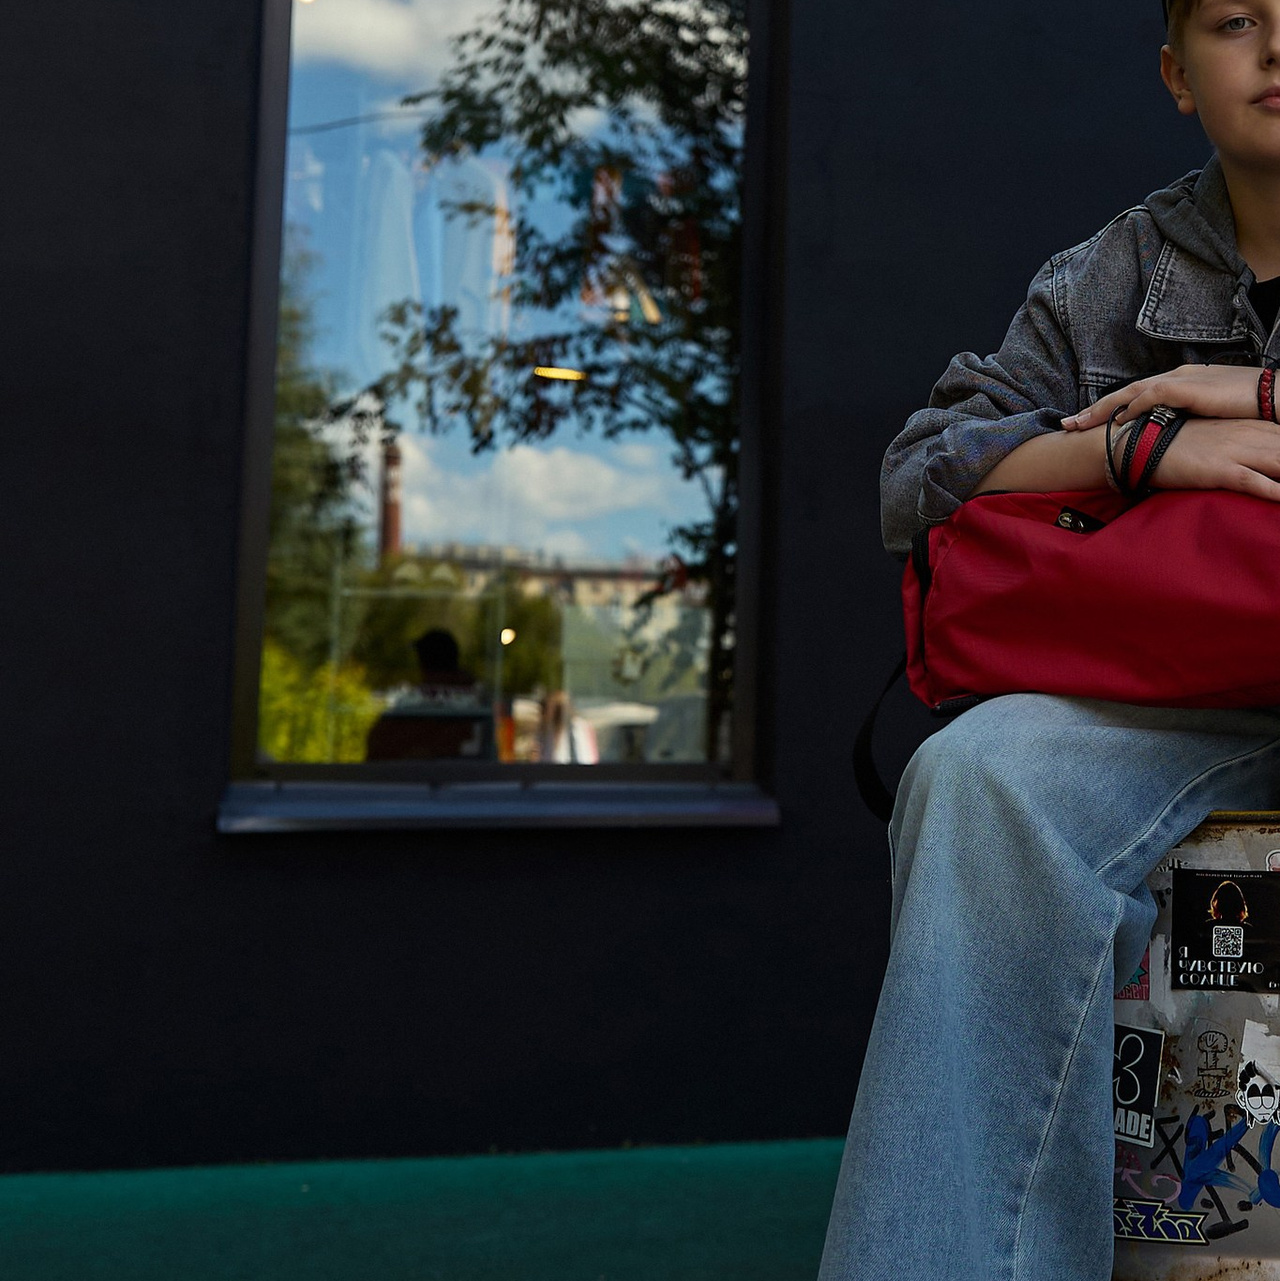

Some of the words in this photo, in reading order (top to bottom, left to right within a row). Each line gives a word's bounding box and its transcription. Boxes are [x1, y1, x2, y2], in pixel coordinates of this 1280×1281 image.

[1178, 946, 1188, 958] Я
[1178, 959, 1265, 974] ЧУВСТВУЮ
[1179, 972, 1240, 987] СОЛНЦЕ
